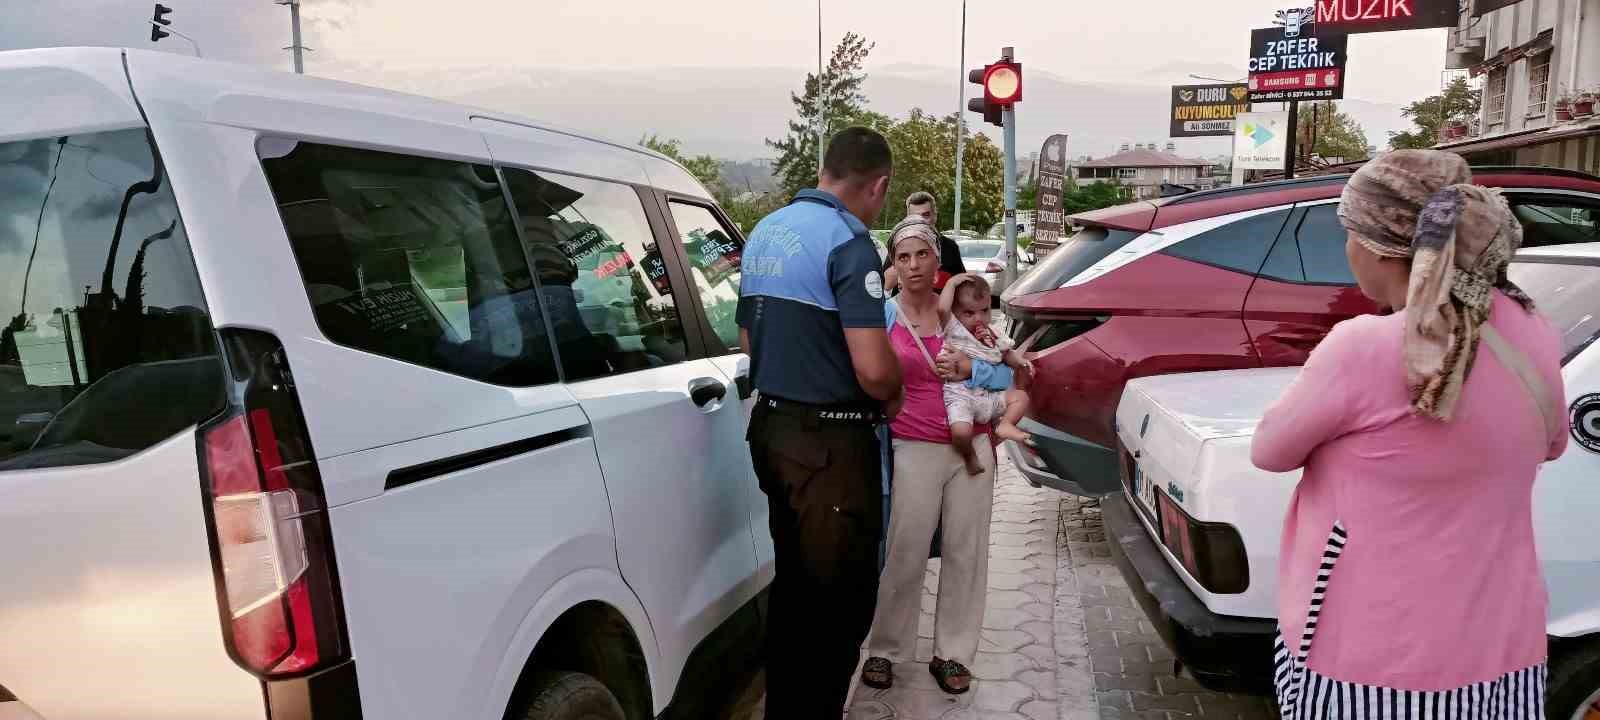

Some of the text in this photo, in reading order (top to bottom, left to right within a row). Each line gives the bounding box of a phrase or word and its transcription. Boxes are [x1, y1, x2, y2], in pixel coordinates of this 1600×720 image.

[1266, 38, 1318, 56] ZAFER
[1248, 56, 1277, 72] CEP
[1264, 77, 1300, 86] SAMSUNG
[1197, 87, 1227, 102] DURU
[1175, 103, 1249, 120] KUYUMCULUK
[1040, 176, 1063, 190] ZAFER
[1042, 193, 1058, 206] CEP
[819, 411, 862, 420] ZABITA
